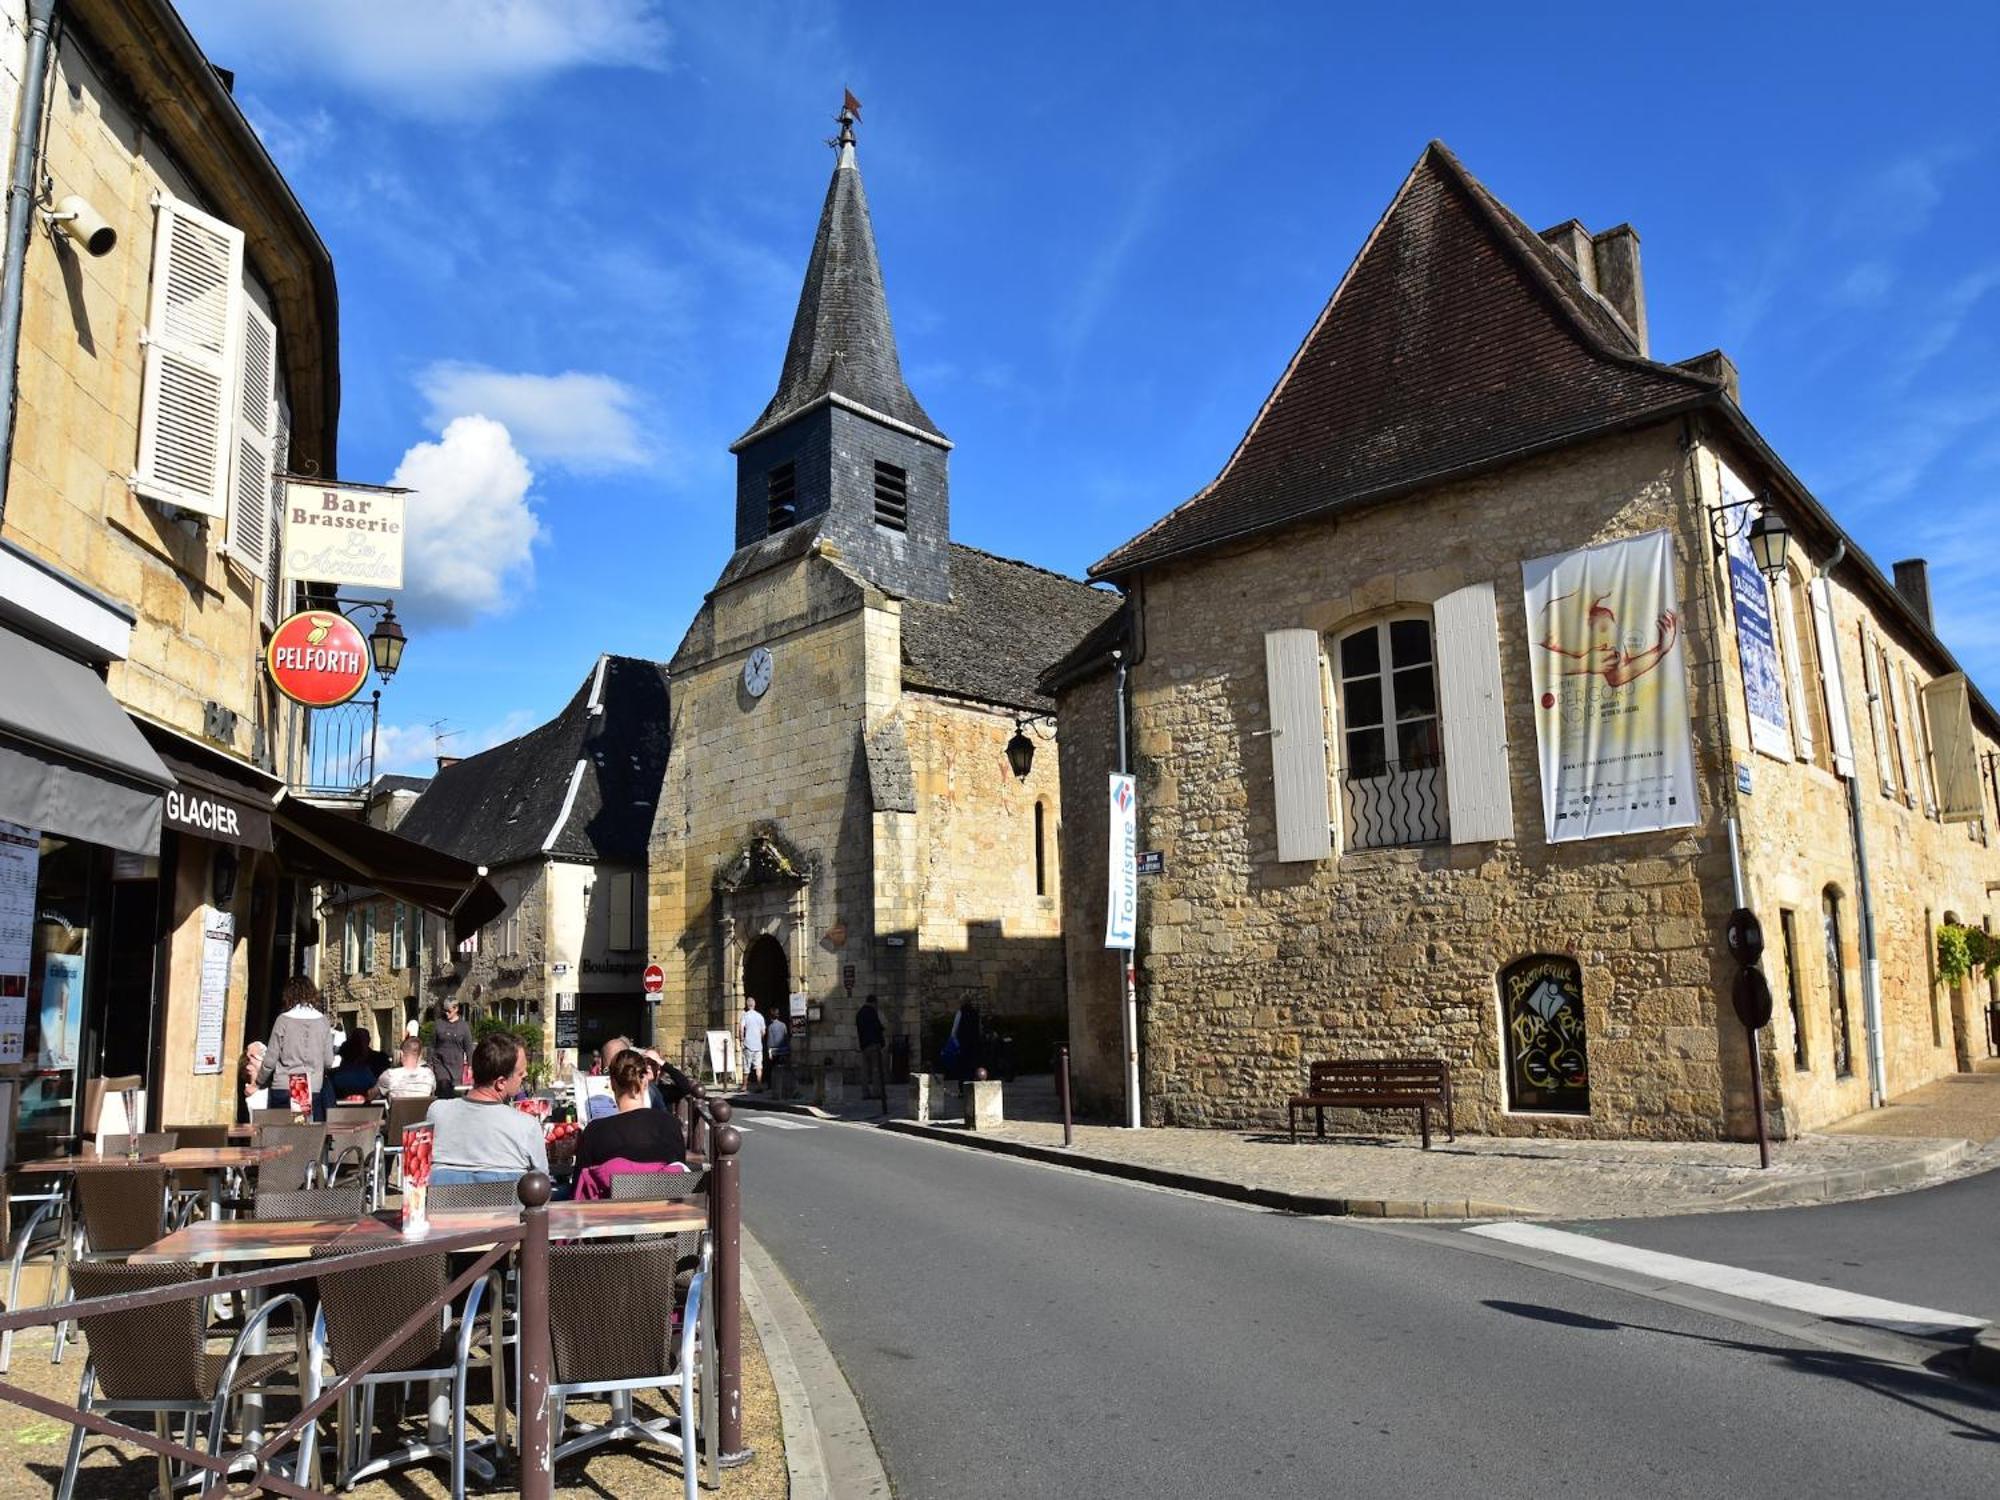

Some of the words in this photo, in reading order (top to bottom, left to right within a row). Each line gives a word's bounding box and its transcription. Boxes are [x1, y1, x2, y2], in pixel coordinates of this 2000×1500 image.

[322, 491, 371, 514] Bar
[292, 508, 400, 534] Brasserie
[276, 647, 360, 675] PELFORTH
[167, 790, 240, 836] GLACIER
[1120, 821, 1135, 923] Tourisme
[1508, 963, 1572, 1000] Bienvenue
